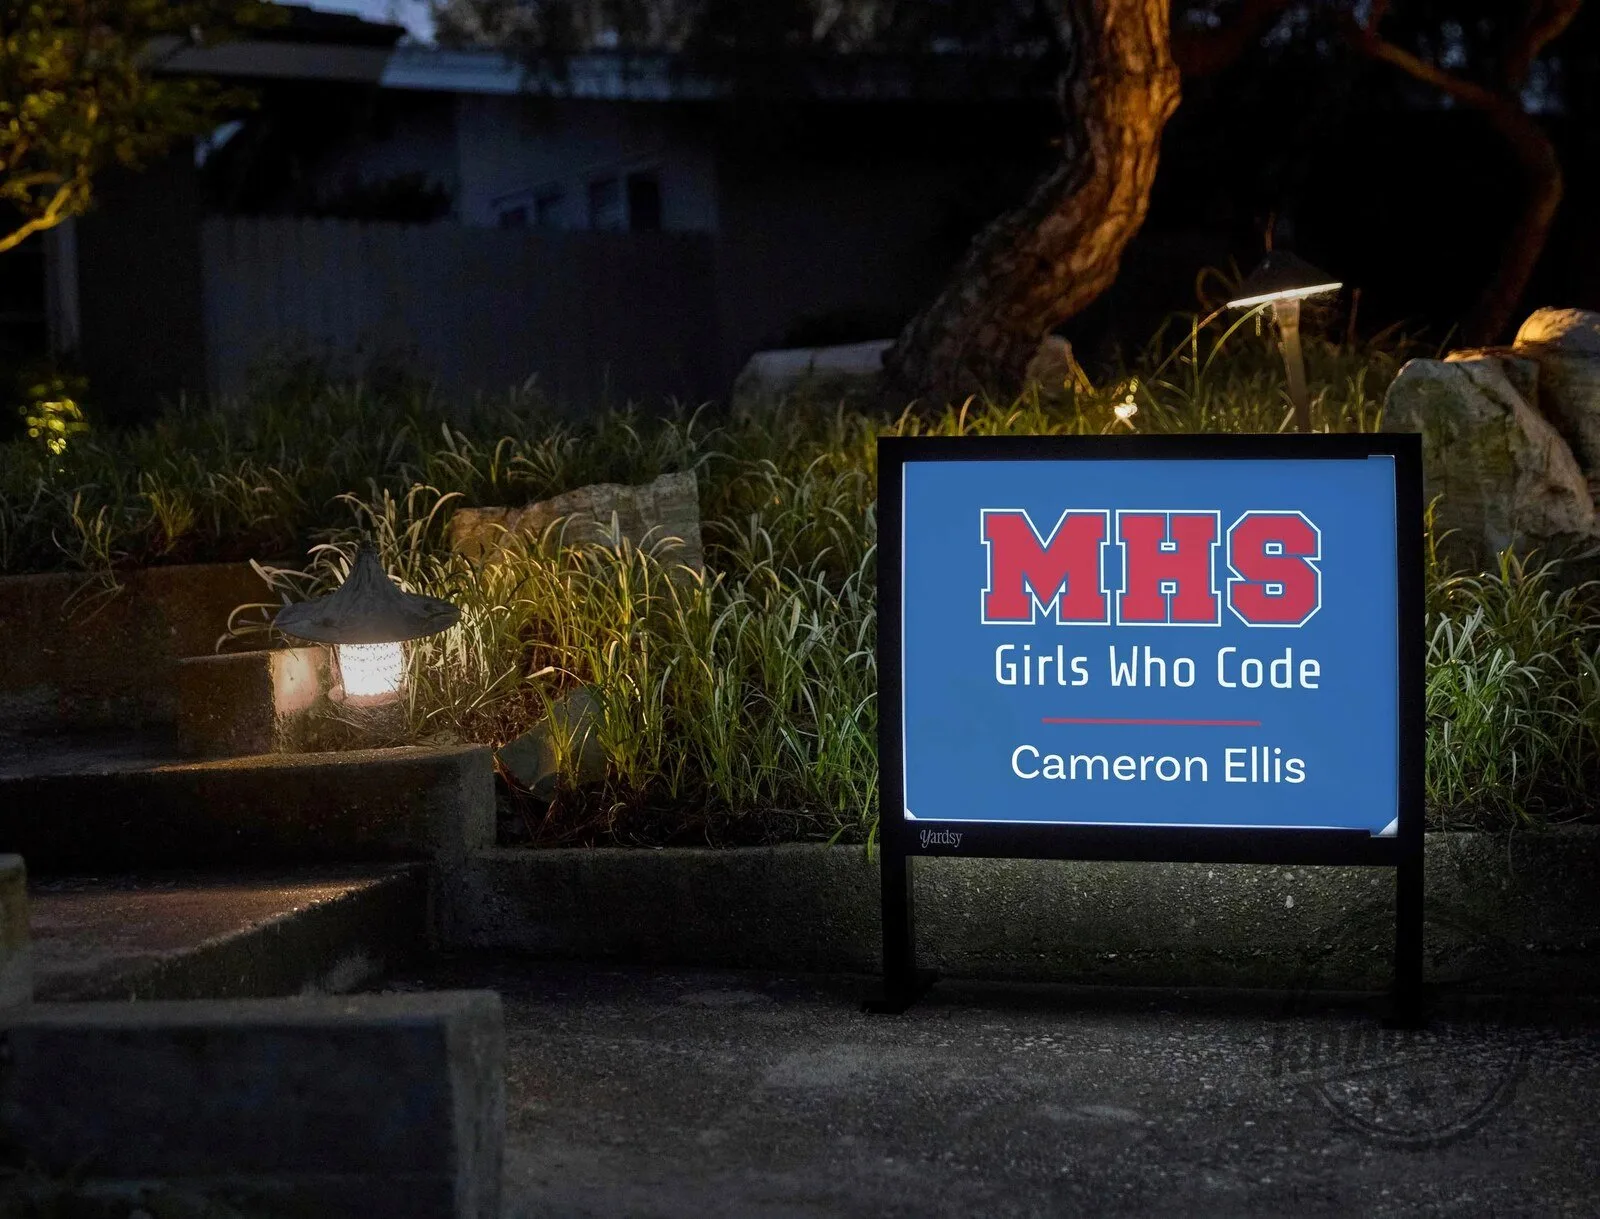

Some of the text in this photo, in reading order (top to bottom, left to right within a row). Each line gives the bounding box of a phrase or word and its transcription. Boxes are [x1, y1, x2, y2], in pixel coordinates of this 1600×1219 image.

[981, 509, 1322, 628] MHS
[995, 644, 1321, 689] Girls Who Code
[1011, 744, 1306, 784] Cameron Ellis
[919, 829, 963, 848] Yardsy
